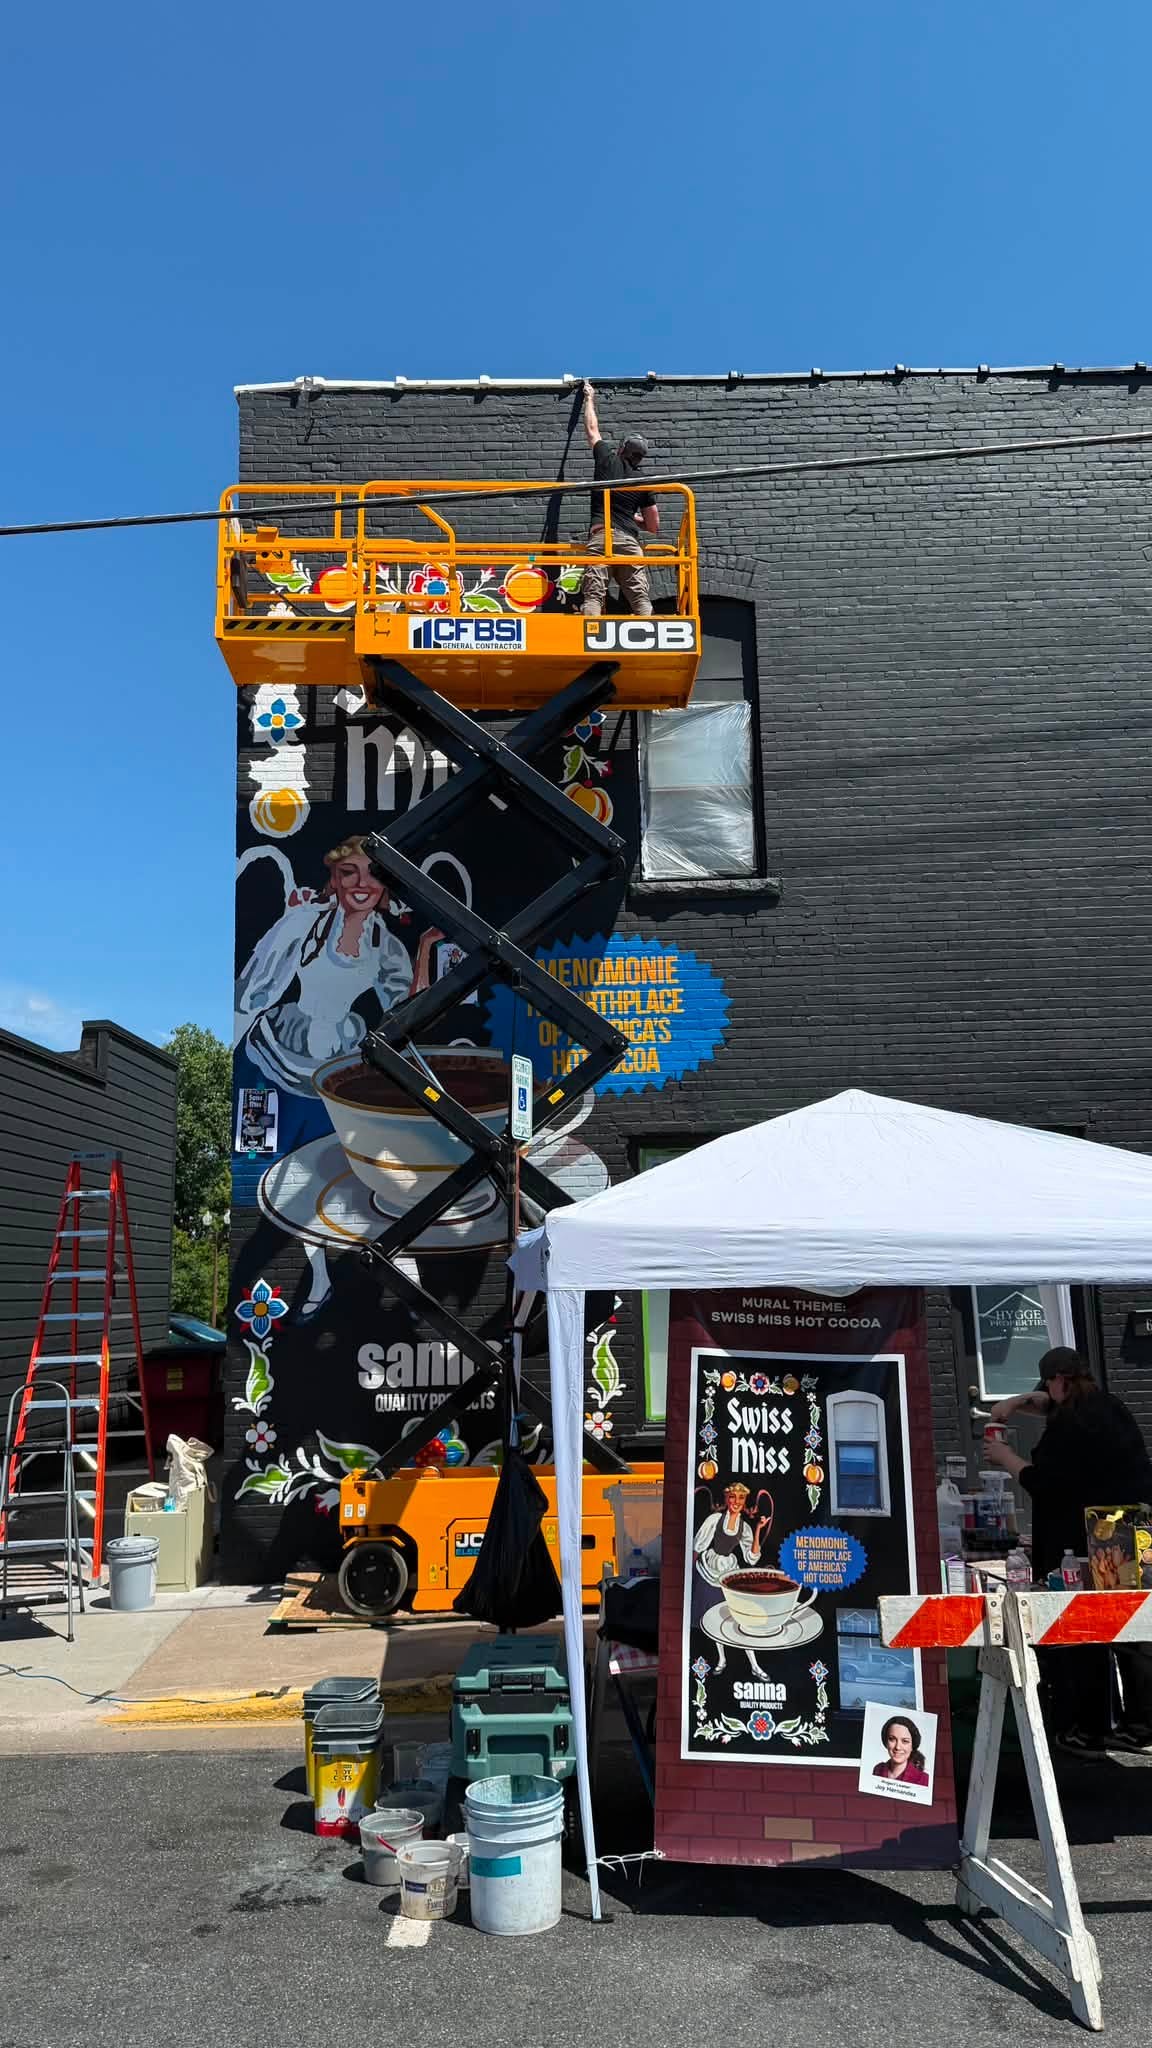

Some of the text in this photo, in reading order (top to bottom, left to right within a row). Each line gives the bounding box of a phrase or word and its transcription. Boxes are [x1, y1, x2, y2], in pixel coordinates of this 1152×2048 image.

[434, 618, 522, 641] CFBSI
[587, 621, 694, 649] JCB
[742, 1297, 847, 1313] MURAL THEME:
[711, 1312, 881, 1329] SWISS MISS HOT COCOA
[995, 1310, 1041, 1320] HYGGE
[375, 1393, 428, 1412] QUALITY
[727, 1397, 794, 1435] Swiss
[731, 1436, 791, 1474] Miss
[795, 1535, 848, 1549] MENOMONIE
[793, 1549, 852, 1561] THE BIRTHPLACE
[798, 1561, 847, 1572] OF AMERICA'S
[803, 1572, 843, 1584] HOT COCOA
[733, 1681, 787, 1701] sanna
